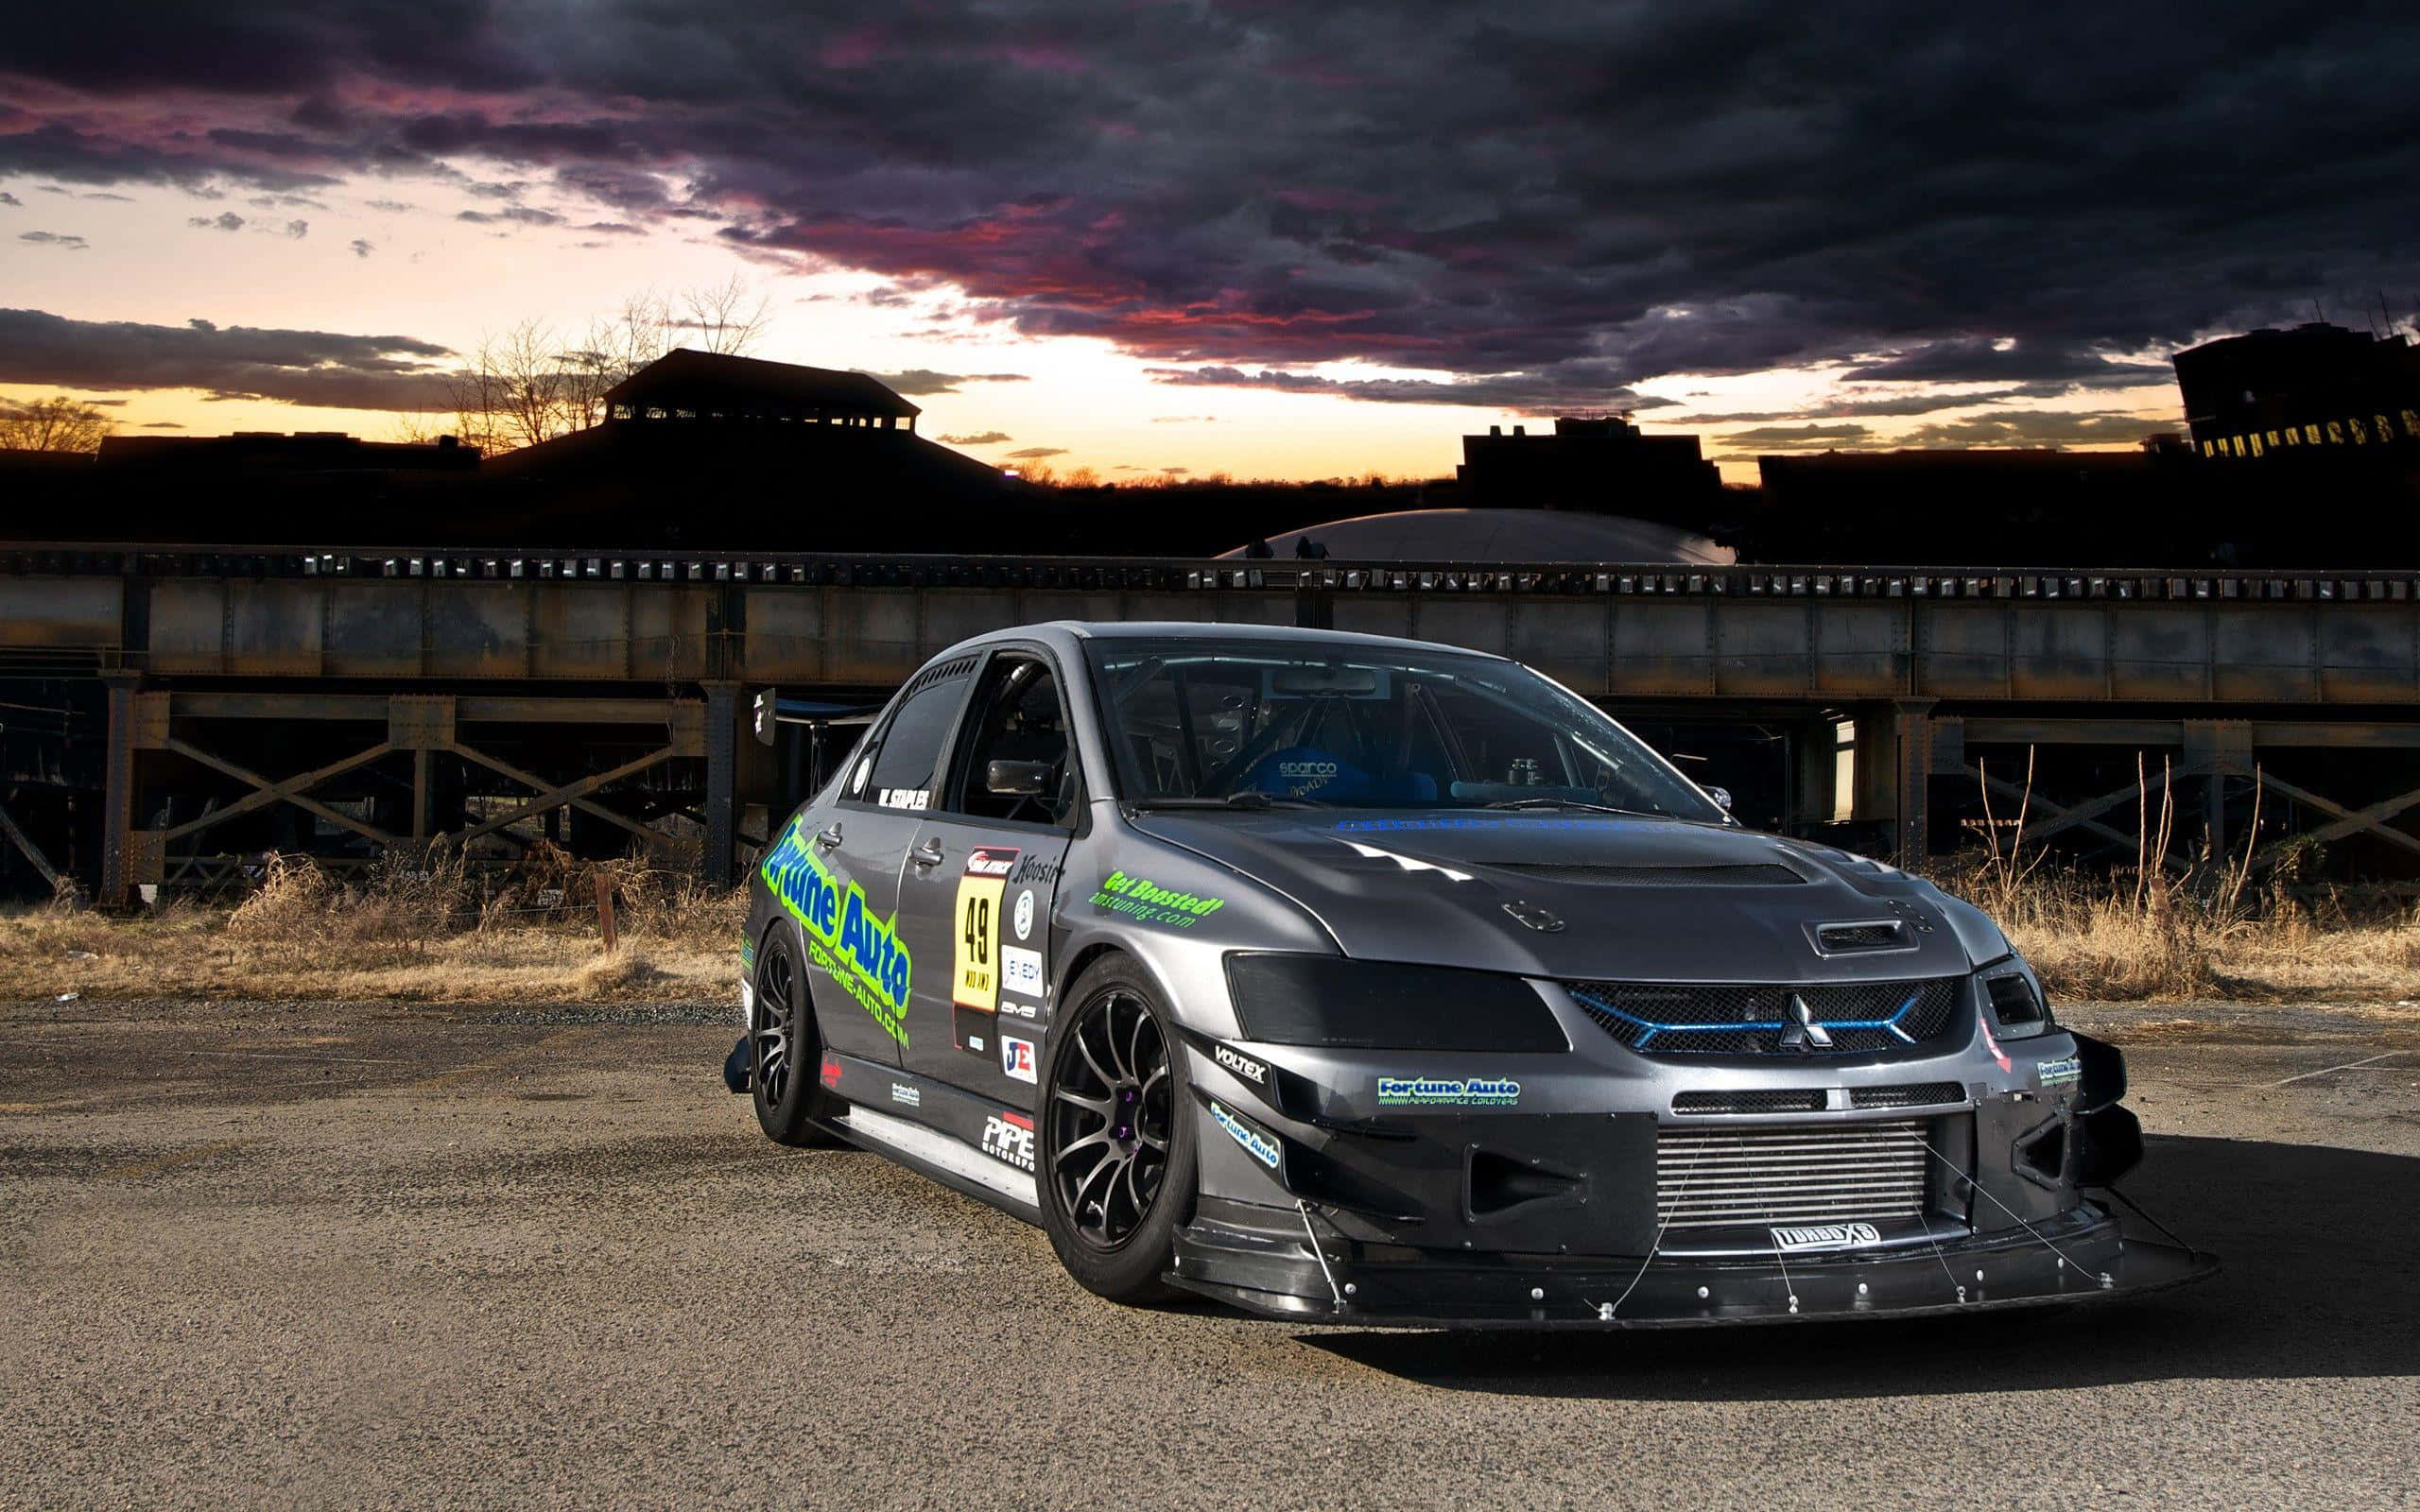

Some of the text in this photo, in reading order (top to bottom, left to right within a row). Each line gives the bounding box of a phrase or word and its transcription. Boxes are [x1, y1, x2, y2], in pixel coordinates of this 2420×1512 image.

[1279, 762, 1338, 777] sparco
[1104, 870, 1225, 917] Get Boosted!
[836, 882, 911, 1017] Auto
[965, 897, 989, 964] 49
[1010, 959, 1041, 981] EEDY
[1007, 1041, 1031, 1072] JE
[1215, 1044, 1266, 1084] VOLTEX
[1378, 1076, 1521, 1097] Fortune Auto
[983, 1115, 1035, 1161] PIPE
[1211, 1101, 1279, 1168] Fortune Auto
[981, 1141, 1035, 1172] MOTORSPO
